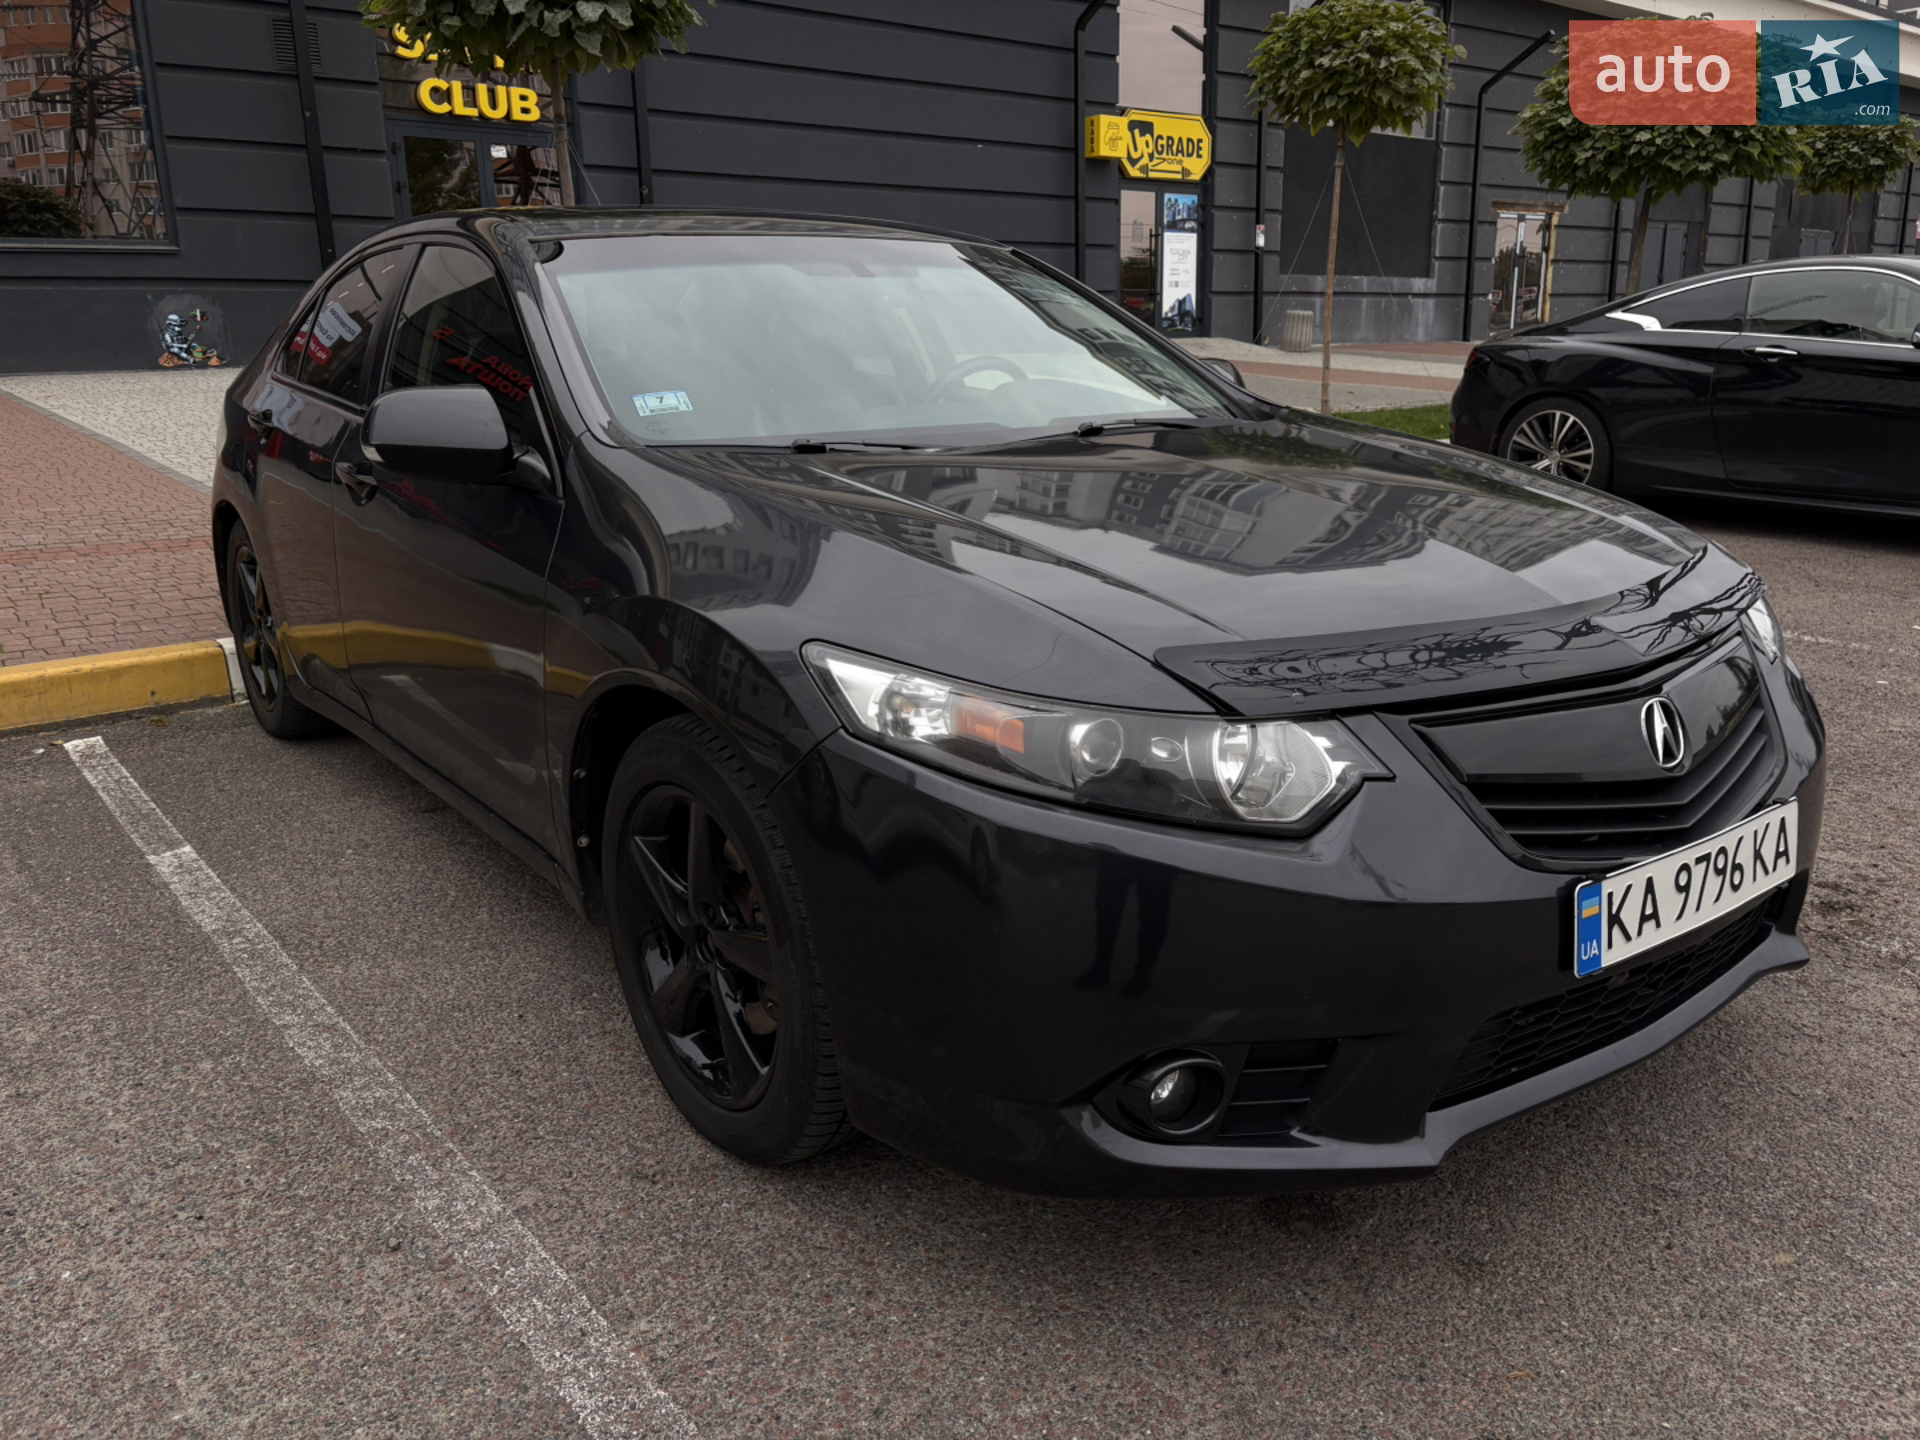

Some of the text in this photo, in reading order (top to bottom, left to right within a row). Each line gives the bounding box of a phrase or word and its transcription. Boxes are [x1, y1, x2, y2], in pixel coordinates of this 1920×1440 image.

[417, 77, 541, 122] CLUB
[1606, 816, 1791, 950] KA 9796 KA
[1580, 939, 1599, 961] UA
